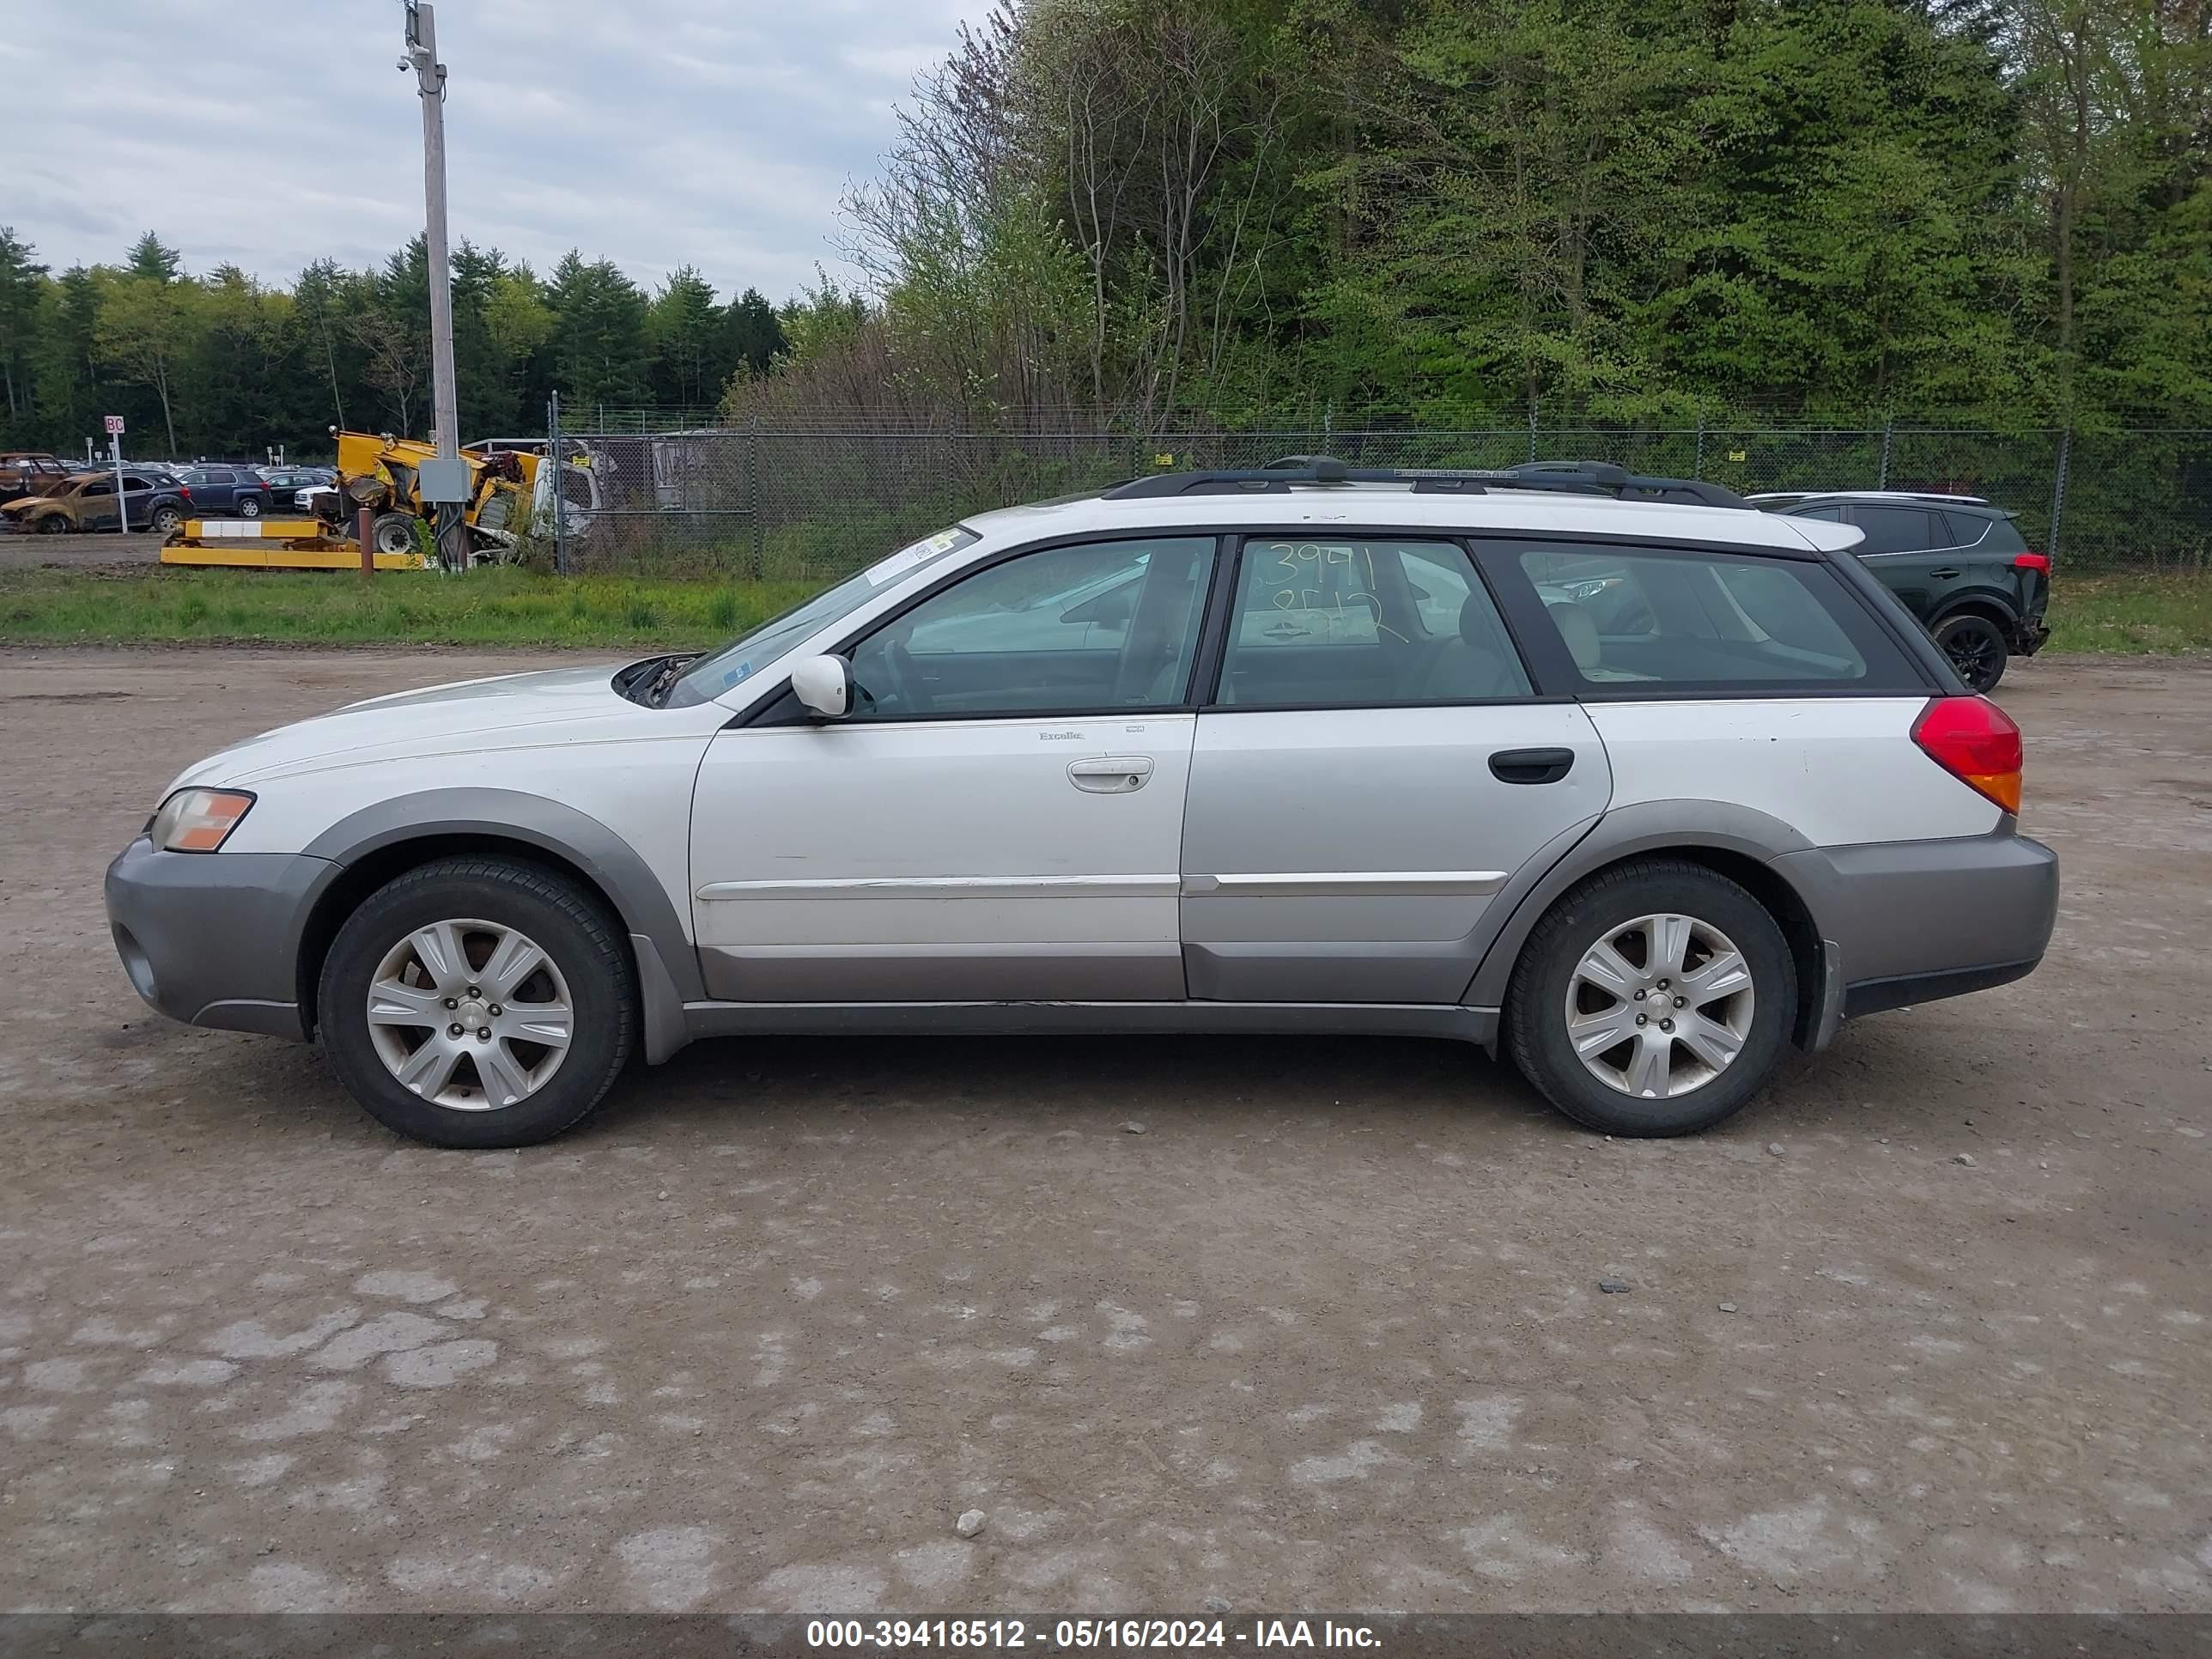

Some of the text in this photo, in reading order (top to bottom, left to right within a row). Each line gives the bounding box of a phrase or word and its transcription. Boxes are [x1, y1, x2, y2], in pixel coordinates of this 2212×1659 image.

[107, 418, 124, 431] BC
[1265, 544, 1376, 591] 3941
[1272, 589, 1410, 644] 8512
